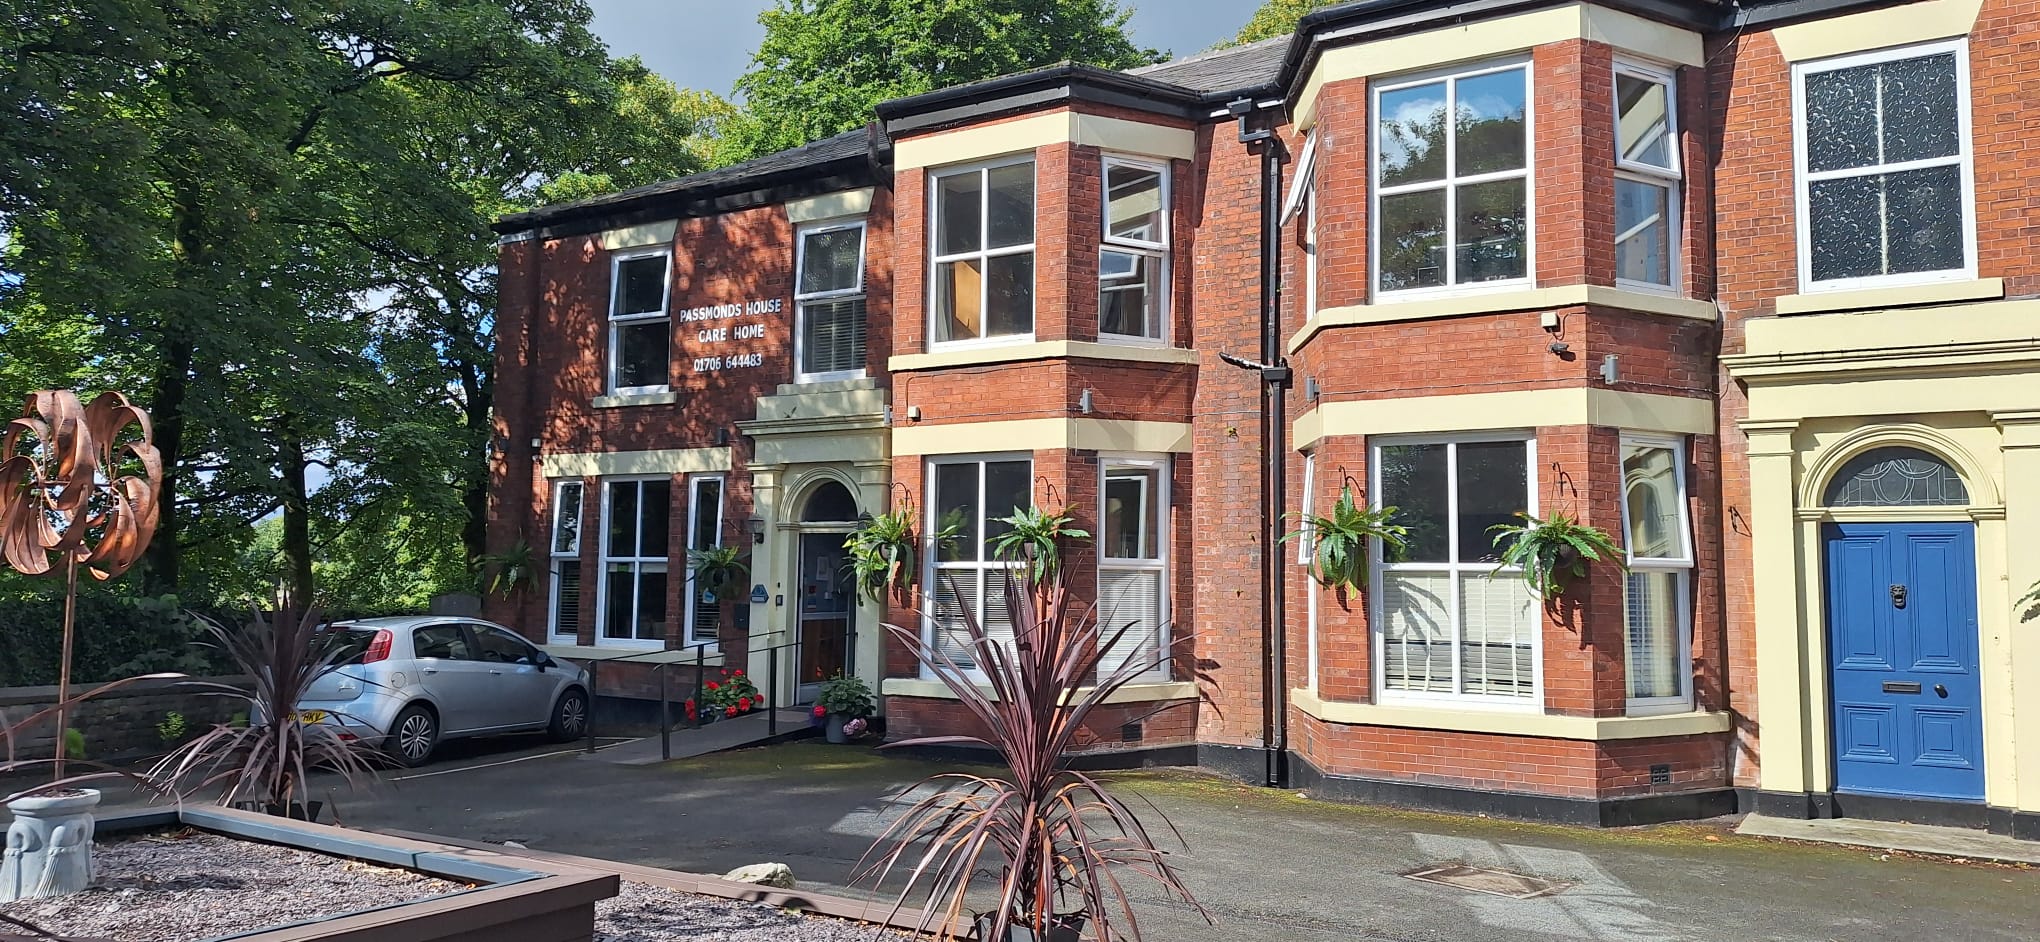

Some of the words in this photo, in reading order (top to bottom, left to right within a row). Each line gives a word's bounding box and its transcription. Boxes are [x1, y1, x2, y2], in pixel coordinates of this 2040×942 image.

[680, 303, 742, 322] PASSMONDS
[746, 299, 781, 316] HOUSE
[698, 327, 727, 343] CARE
[734, 324, 764, 340] HOME
[693, 357, 721, 372] 01706
[725, 353, 762, 369] 644483
